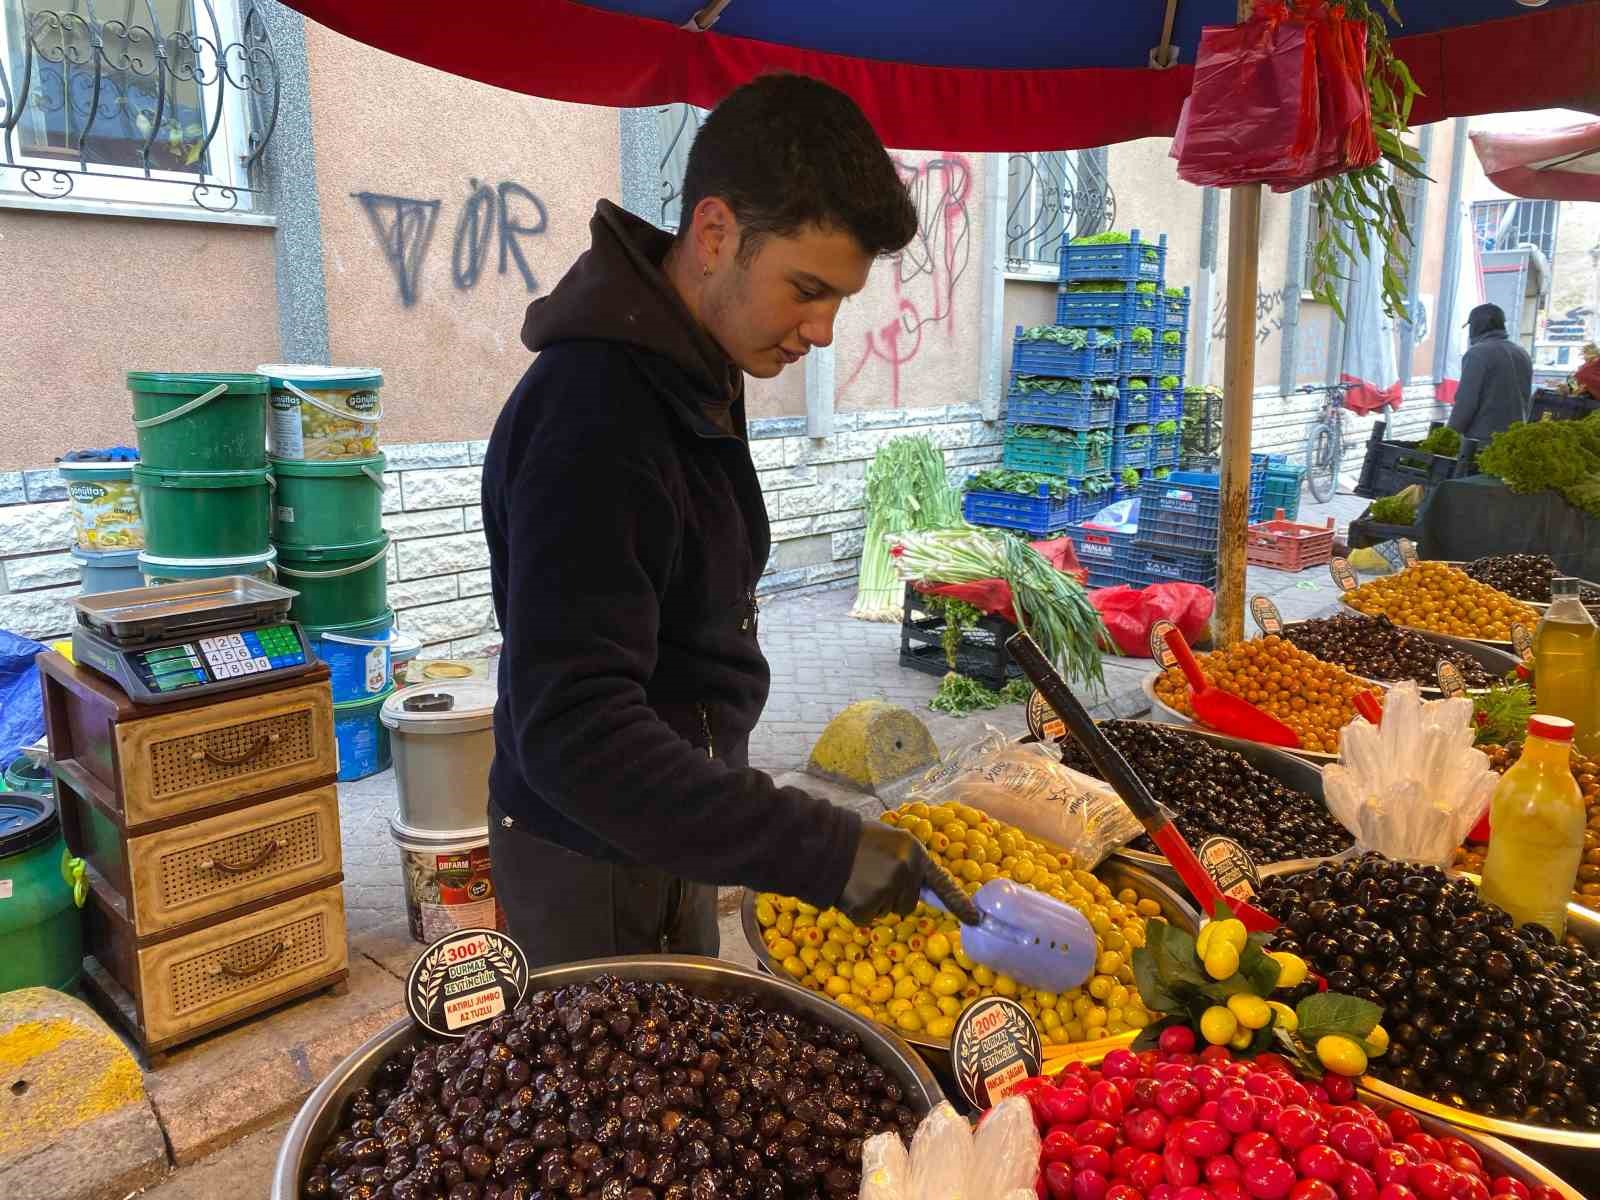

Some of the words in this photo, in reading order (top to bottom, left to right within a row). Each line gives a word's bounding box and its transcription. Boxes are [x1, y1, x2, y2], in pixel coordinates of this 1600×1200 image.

[218, 638, 226, 647] 2
[232, 636, 241, 645] 3
[211, 654, 219, 662] 4
[225, 651, 233, 660] 5
[239, 649, 247, 657] 6
[215, 667, 225, 676] 7
[231, 665, 240, 673] 8
[246, 662, 254, 671] 9
[448, 958, 487, 979] DURMAZ
[446, 998, 474, 1014] KATIRLI
[475, 991, 500, 1005] JUMBO
[460, 1012, 470, 1022] AZ
[471, 1005, 492, 1019] TUZLU
[981, 1029, 1009, 1053] DURMAZ
